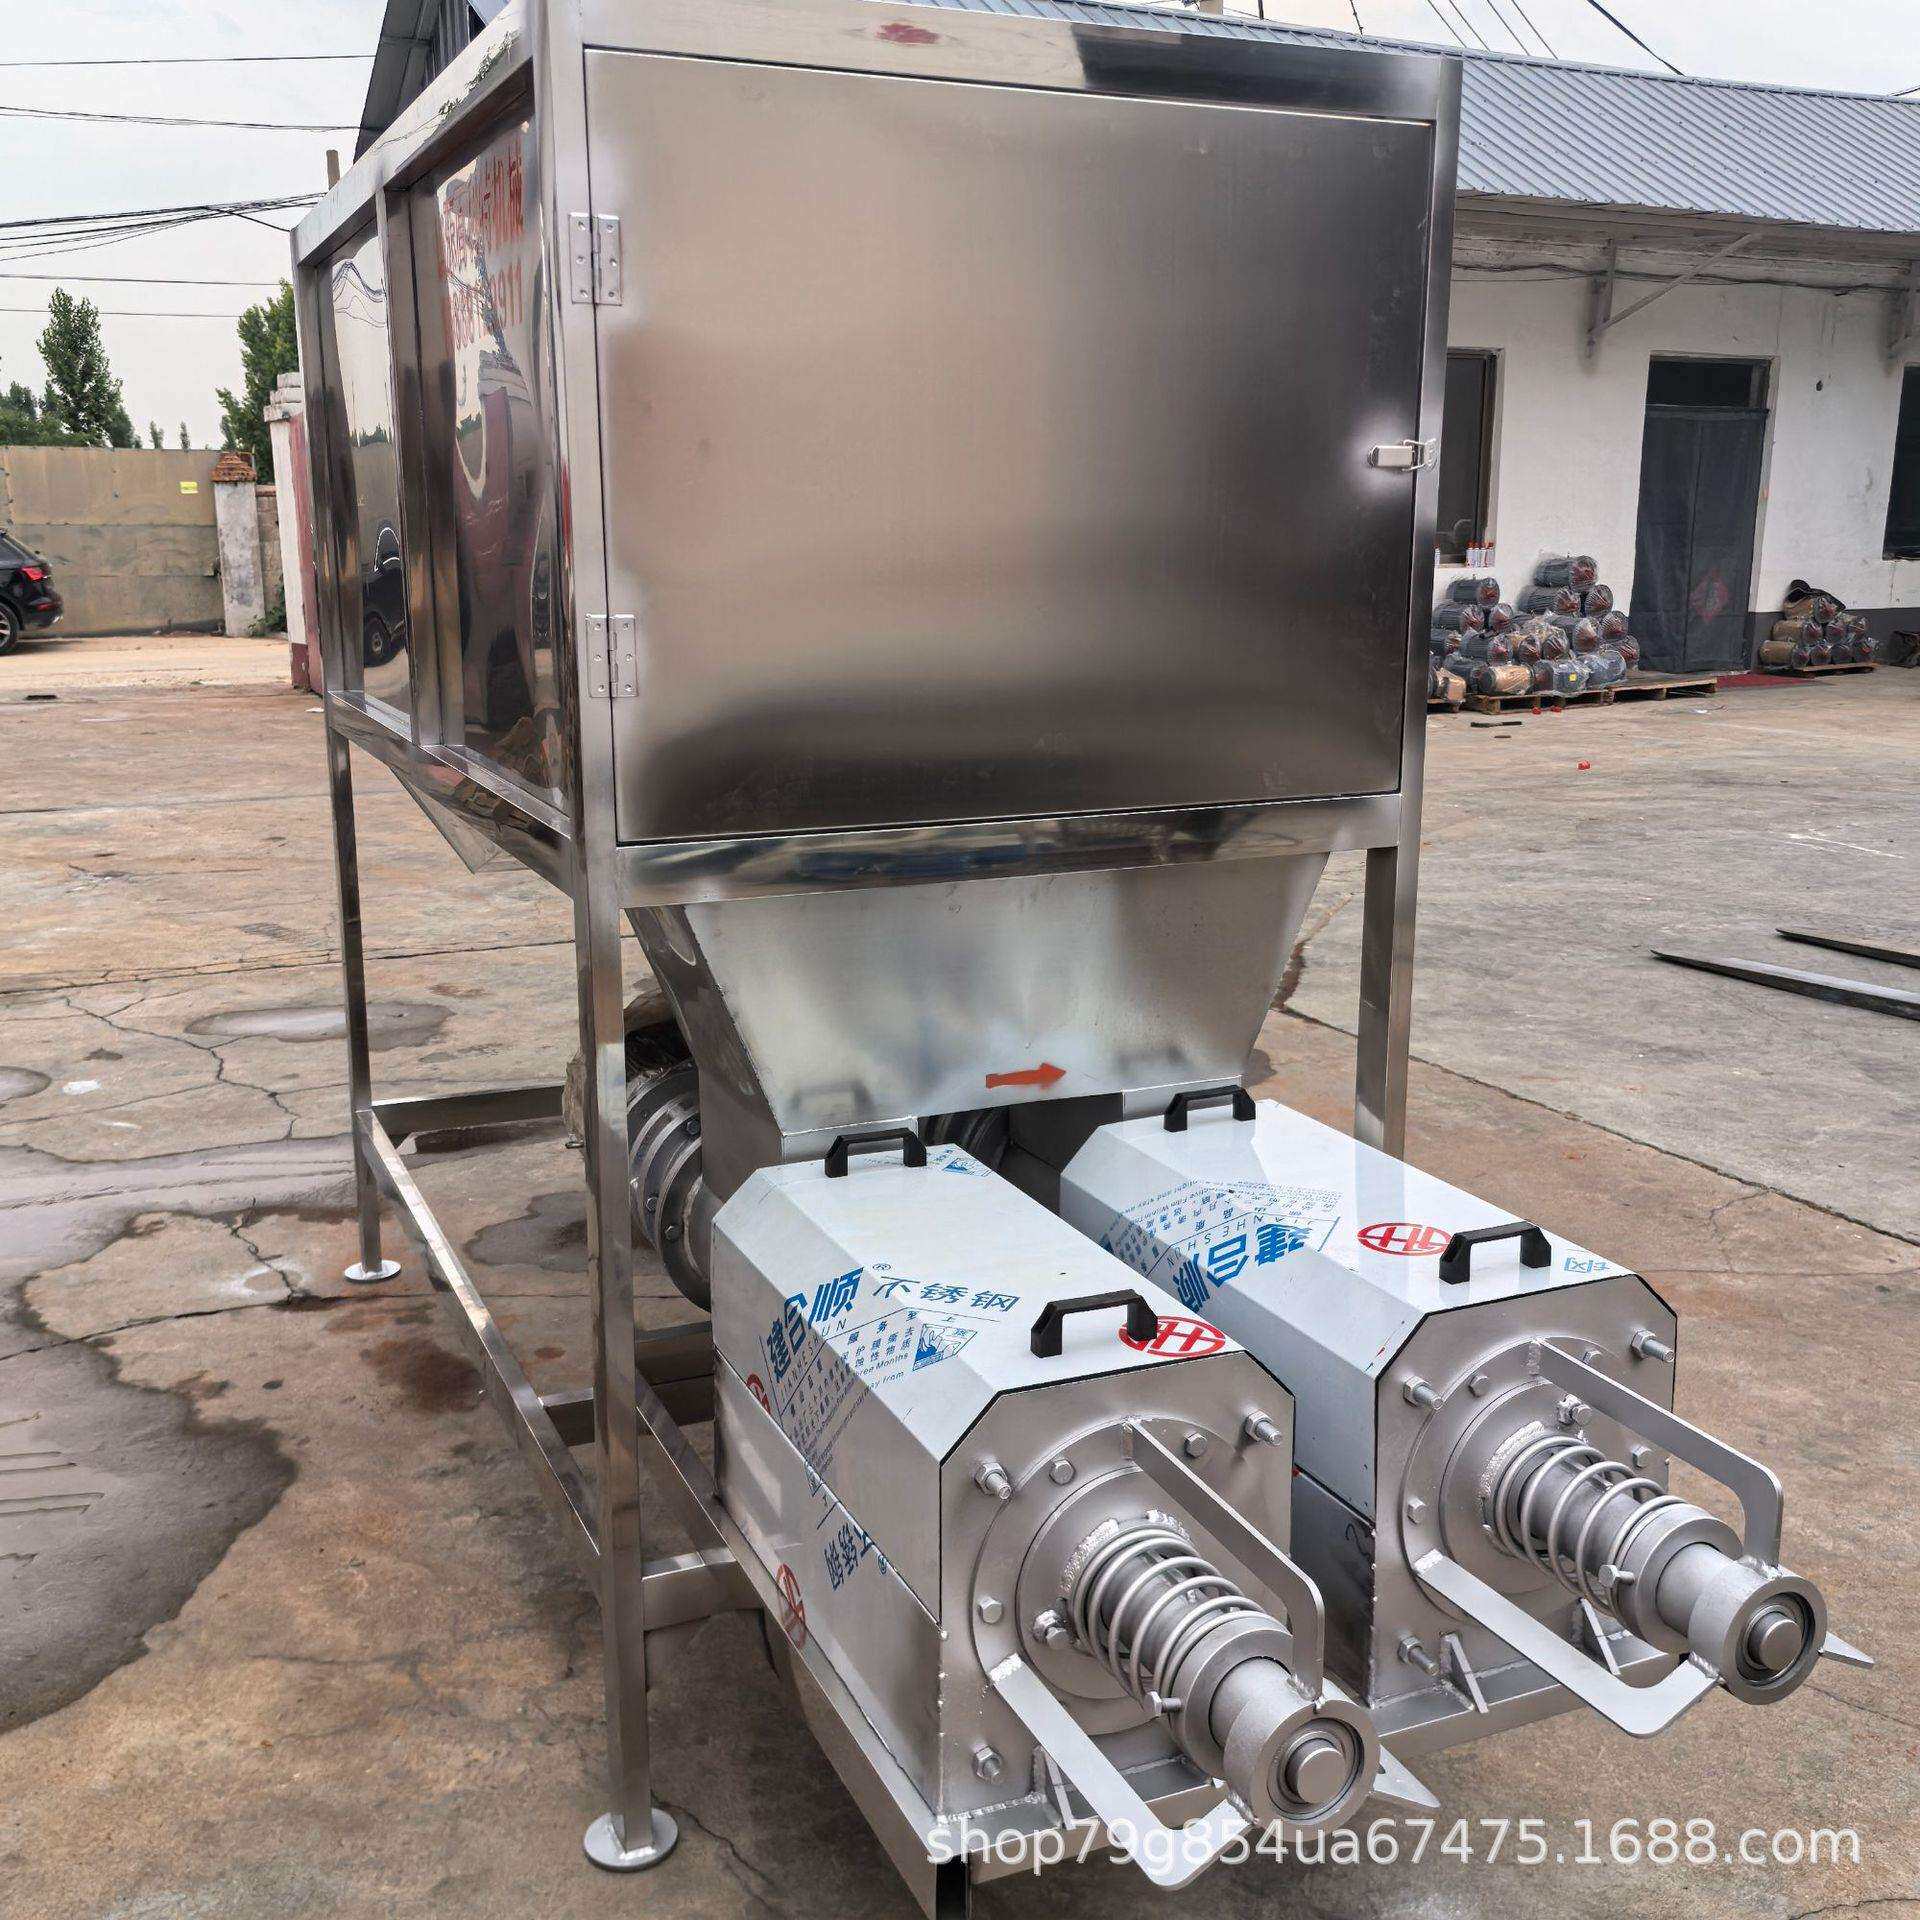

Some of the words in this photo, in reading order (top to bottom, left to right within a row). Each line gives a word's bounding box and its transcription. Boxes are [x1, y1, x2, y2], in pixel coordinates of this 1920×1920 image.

[1172, 1223, 1312, 1313] 建合顺
[767, 1267, 864, 1383] 建合顺
[872, 1275, 1021, 1312] 不锈钢
